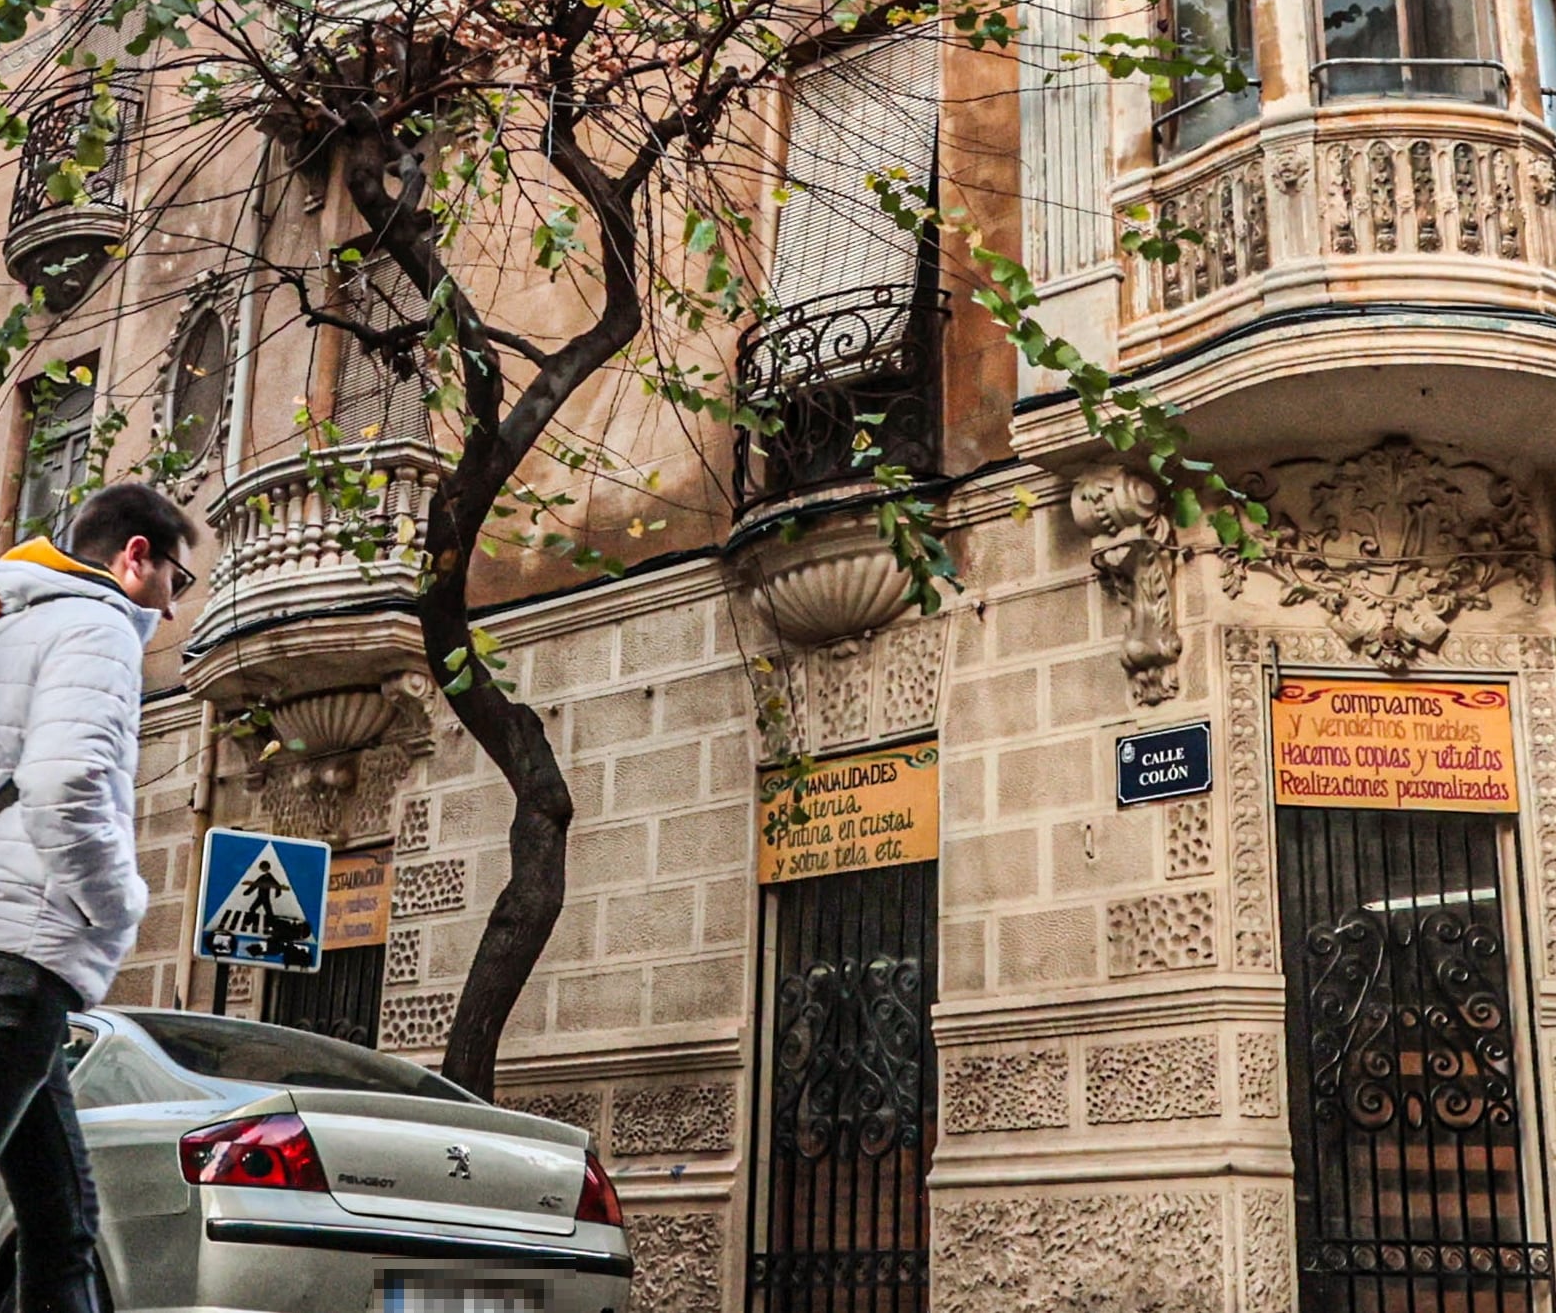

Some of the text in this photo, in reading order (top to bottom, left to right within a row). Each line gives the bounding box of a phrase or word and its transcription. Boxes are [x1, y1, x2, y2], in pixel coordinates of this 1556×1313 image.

[1311, 714, 1406, 740] vendemos
[1412, 717, 1482, 743] muebles
[1141, 747, 1185, 766] CALLE
[1281, 742, 1503, 777] Hacemos copias y retratos
[1138, 763, 1189, 786] COLÓN
[1279, 769, 1510, 807] Realizaciones personalizadas
[838, 819, 856, 842] en
[771, 858, 785, 880] y
[789, 849, 830, 874] sobre
[834, 841, 870, 868] tela
